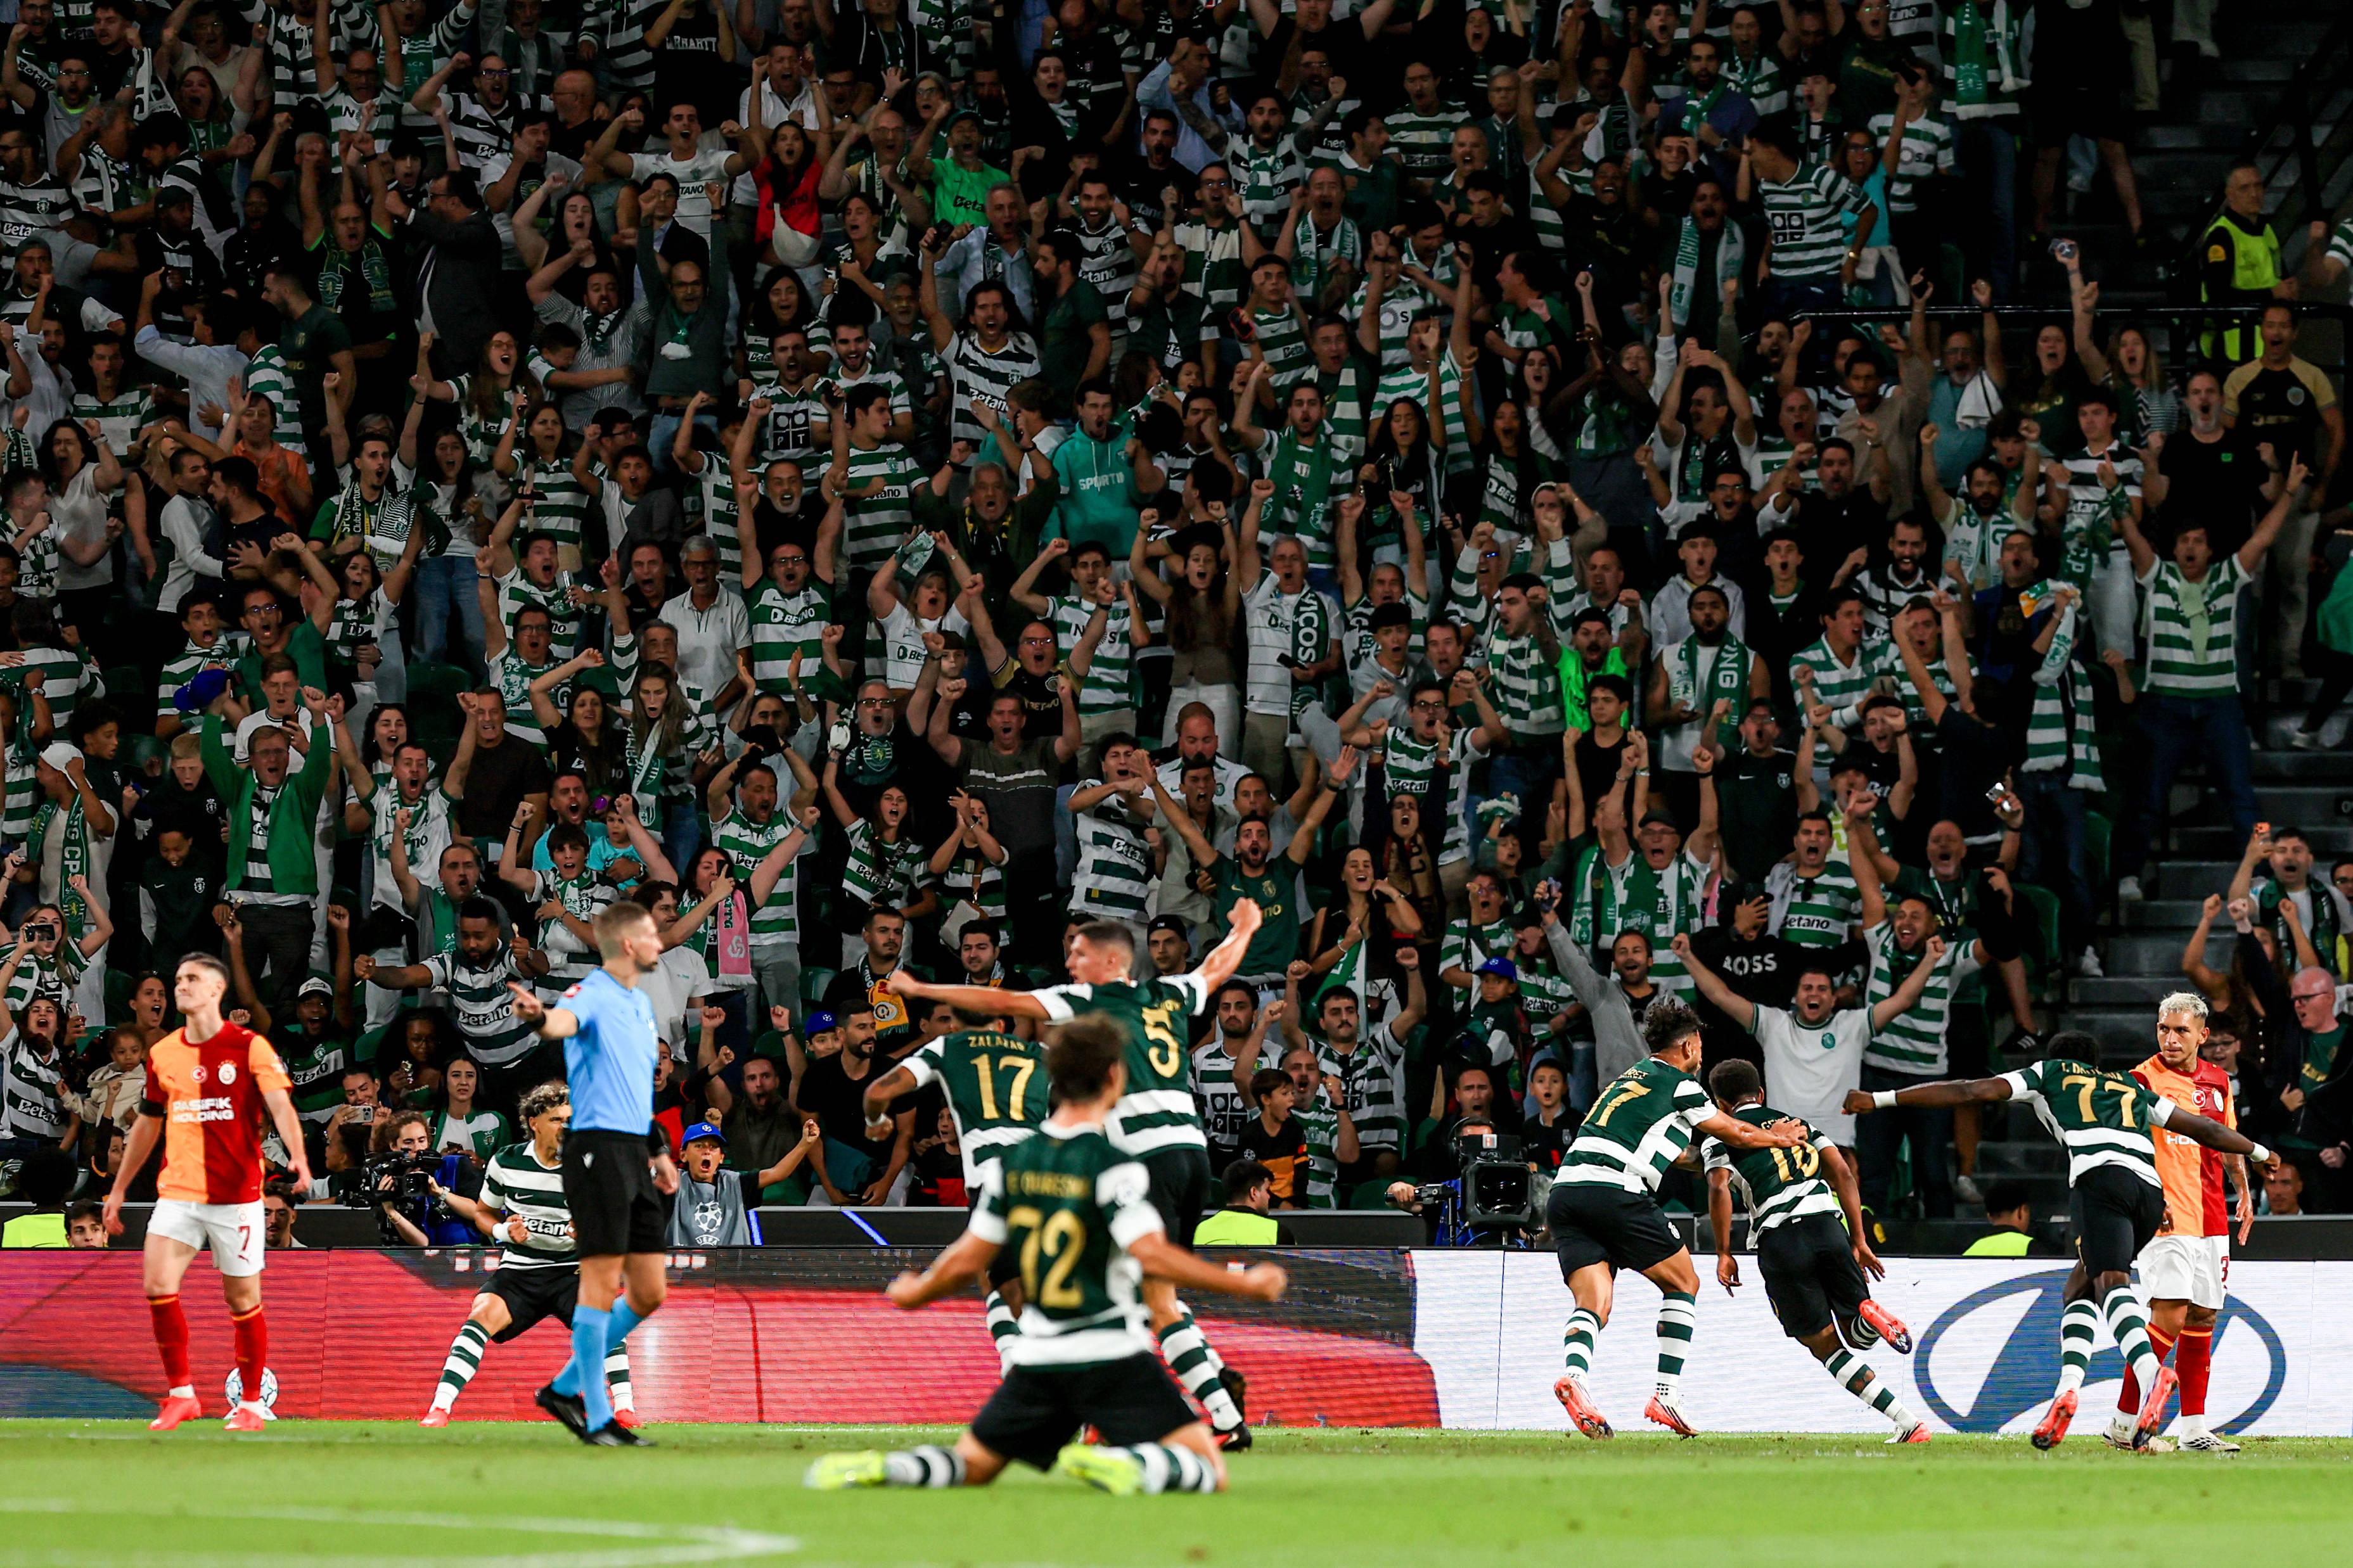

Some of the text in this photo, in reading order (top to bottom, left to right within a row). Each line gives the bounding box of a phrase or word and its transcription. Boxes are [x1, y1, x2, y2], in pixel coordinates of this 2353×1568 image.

[856, 864, 894, 892] Betao
[1141, 1006, 1180, 1078] 5
[291, 1062, 329, 1083] etano
[971, 1052, 1036, 1122] 17
[17, 1099, 62, 1127] Betano
[2062, 1074, 2138, 1128] 77
[1769, 1142, 1819, 1183] 10
[238, 1225, 251, 1251] 7
[696, 1235, 718, 1246] UEFA
[1006, 1205, 1087, 1309] 72
